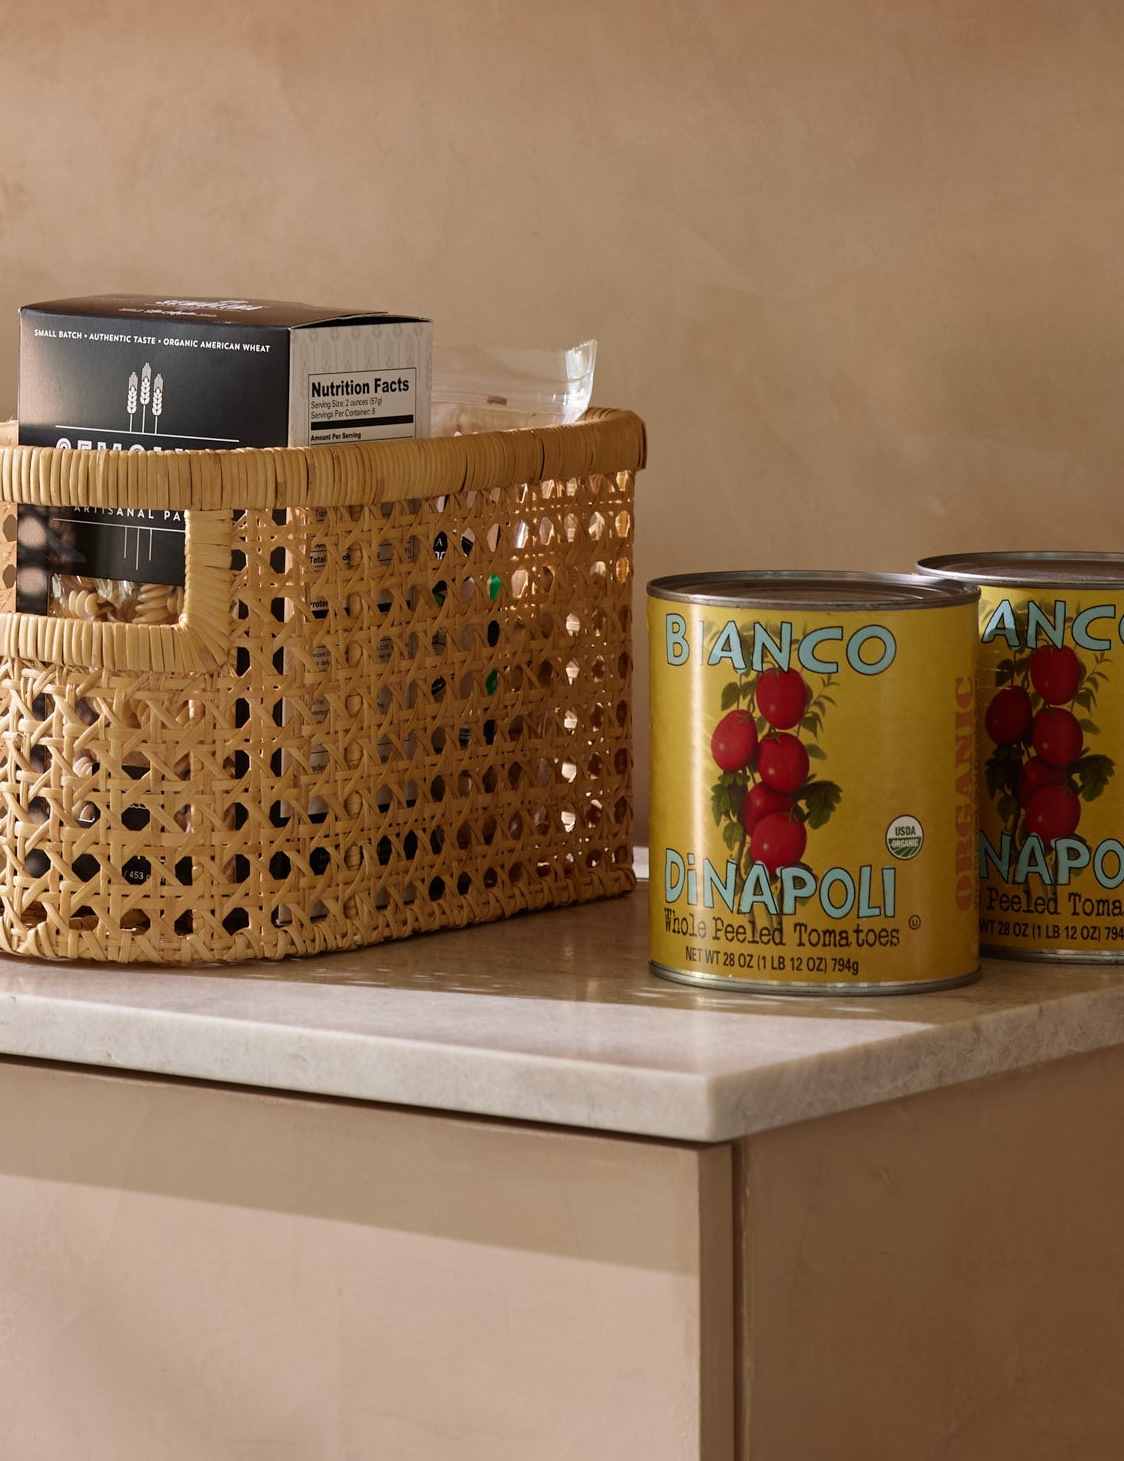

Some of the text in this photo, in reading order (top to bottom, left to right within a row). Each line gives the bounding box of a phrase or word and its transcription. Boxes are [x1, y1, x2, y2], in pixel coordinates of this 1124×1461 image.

[34, 329, 271, 353] SMALL BATCH AUTHENTIC TASTE ORGANIC AMERICAN WHEAT
[311, 376, 410, 398] Nutrition Facts
[310, 399, 331, 410] Serving
[332, 398, 345, 408] Size:
[350, 399, 368, 407] ounces
[369, 396, 383, 407] (57g)
[310, 410, 334, 420] Servings
[334, 409, 344, 417] Per
[345, 408, 371, 417] Container:
[310, 431, 362, 442] Amount Per Serving
[74, 505, 155, 520] ARTISANAL
[980, 598, 1124, 652] ANC
[664, 612, 898, 676] BIANCO
[955, 677, 974, 912] ORGANIC
[895, 826, 916, 836] USDA
[892, 838, 919, 848] ORGANIC
[979, 829, 1124, 890] NAPO
[986, 886, 1124, 917] Peeled Toma
[664, 907, 901, 948] Whole Peeled Tomatoes
[979, 919, 1124, 942] WT 28 OZ (1 LB 12 OZ) 794
[685, 945, 859, 975] NET WT 28 OZ (1 LB 12 OZ) 794g
